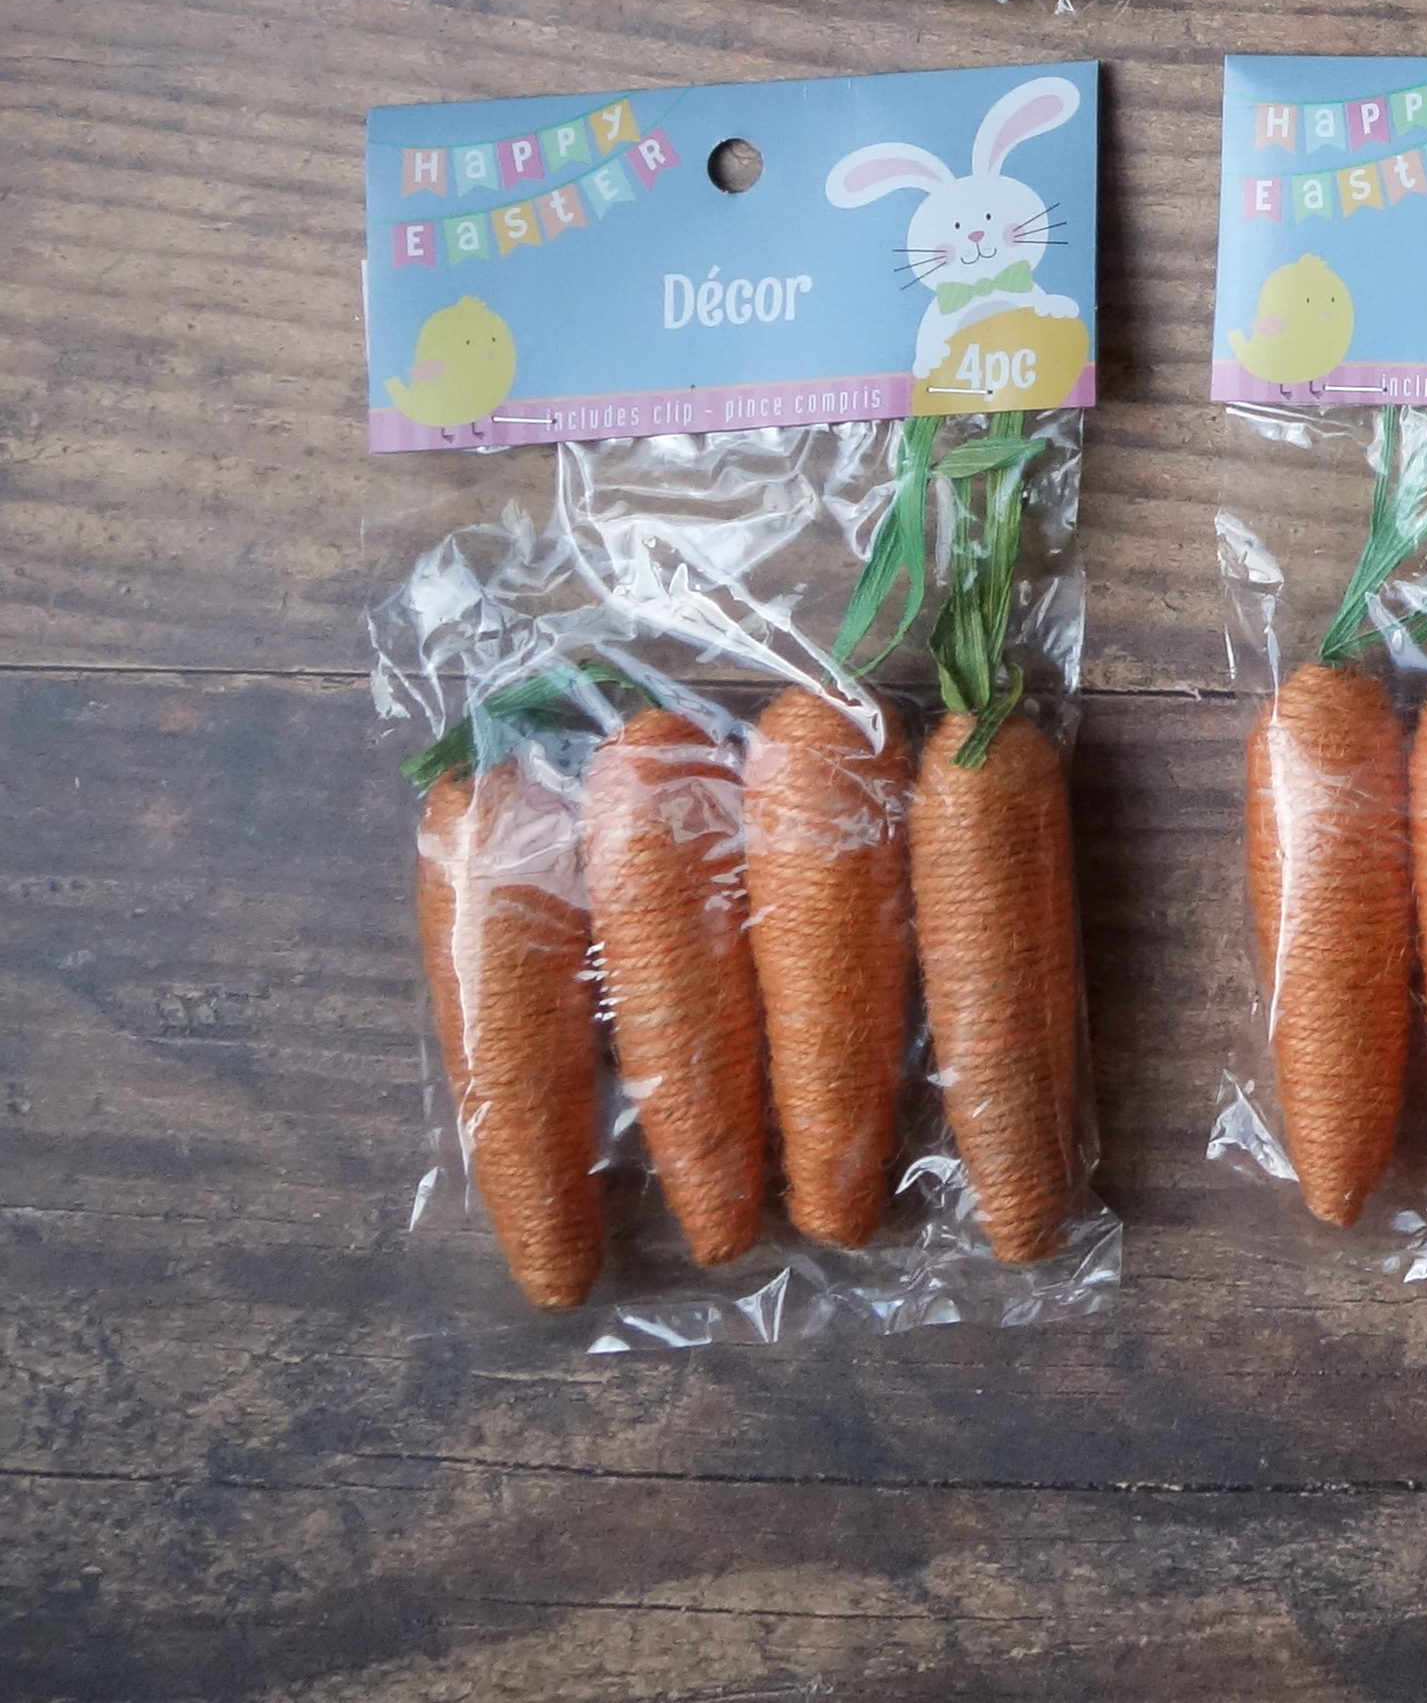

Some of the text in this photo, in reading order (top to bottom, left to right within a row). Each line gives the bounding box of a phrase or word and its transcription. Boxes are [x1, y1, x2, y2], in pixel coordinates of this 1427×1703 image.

[663, 263, 813, 330] Décor
[956, 345, 1037, 398] 4pc
[546, 406, 640, 432] includes
[653, 402, 693, 428] clip
[725, 395, 783, 423] pince
[794, 386, 883, 415] compris
